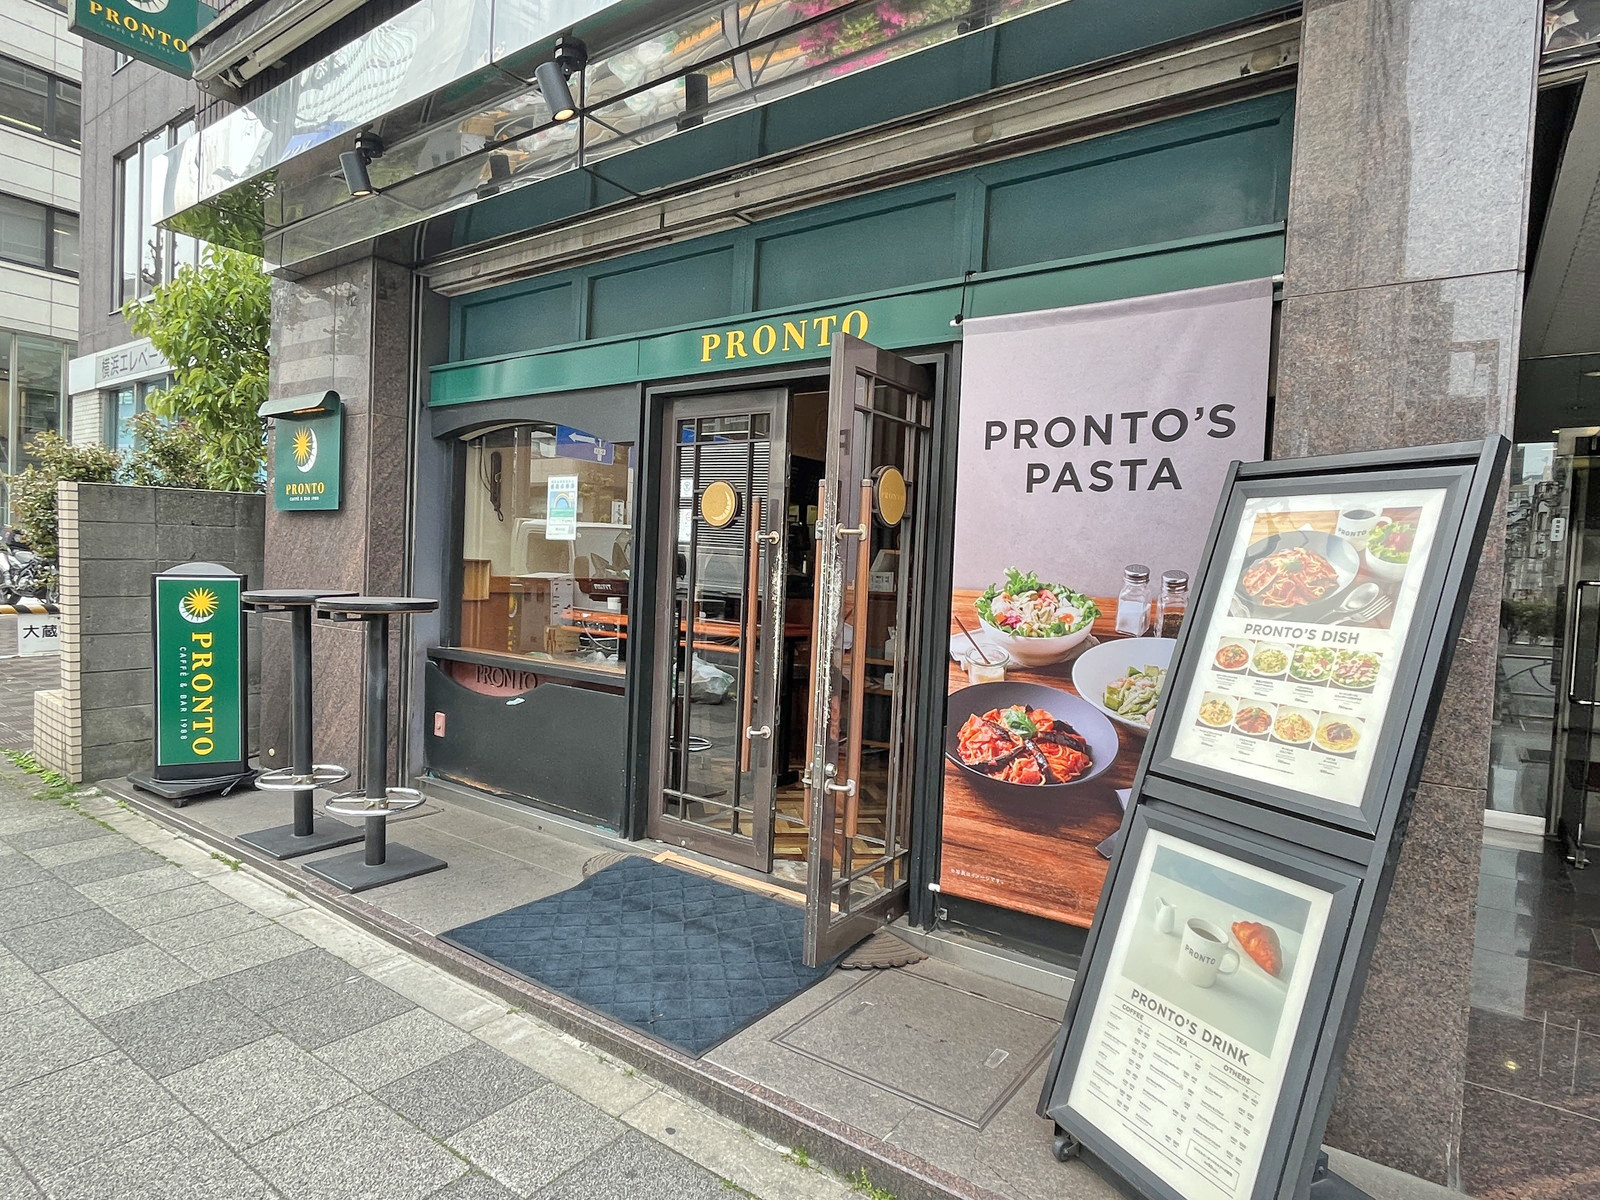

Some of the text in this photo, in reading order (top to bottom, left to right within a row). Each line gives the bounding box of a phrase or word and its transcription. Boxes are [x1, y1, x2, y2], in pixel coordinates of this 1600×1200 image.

[89, 0, 188, 53] PRONTO
[700, 310, 869, 362] PRONTO
[984, 403, 1236, 450] PRONTO’S
[1026, 457, 1183, 493] PASTA
[285, 482, 325, 495] PRONTO
[23, 625, 58, 639] 大蔵
[1244, 623, 1360, 645] PRONTO’S DISH
[180, 695, 188, 712] BAR
[191, 632, 214, 756] PRONTO
[180, 719, 188, 740] 1988
[1185, 944, 1216, 965] PRONTO
[1122, 1003, 1144, 1021] COFFEE
[1130, 988, 1250, 1067] PRONTO’S DRINK
[1176, 1035, 1188, 1047] TEA
[1223, 1064, 1251, 1085] OTHERS
